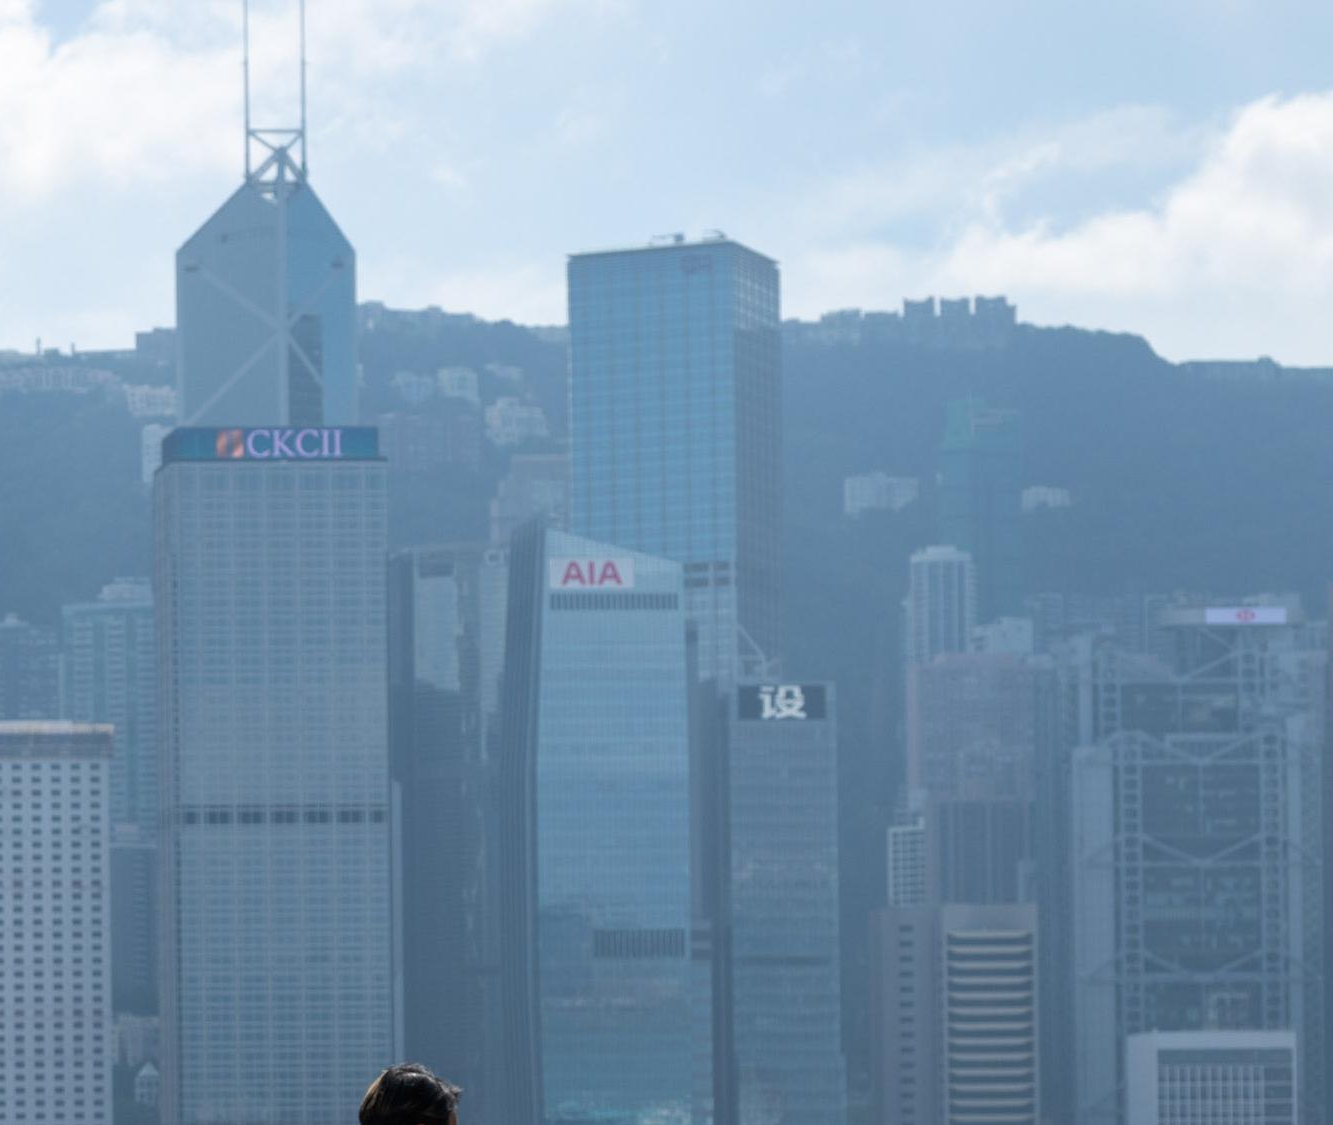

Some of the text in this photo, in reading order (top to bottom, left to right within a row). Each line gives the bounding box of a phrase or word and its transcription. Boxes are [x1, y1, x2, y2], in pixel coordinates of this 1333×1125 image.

[246, 428, 342, 459] CKCII
[562, 560, 623, 586] AIA
[758, 684, 807, 720] 设
